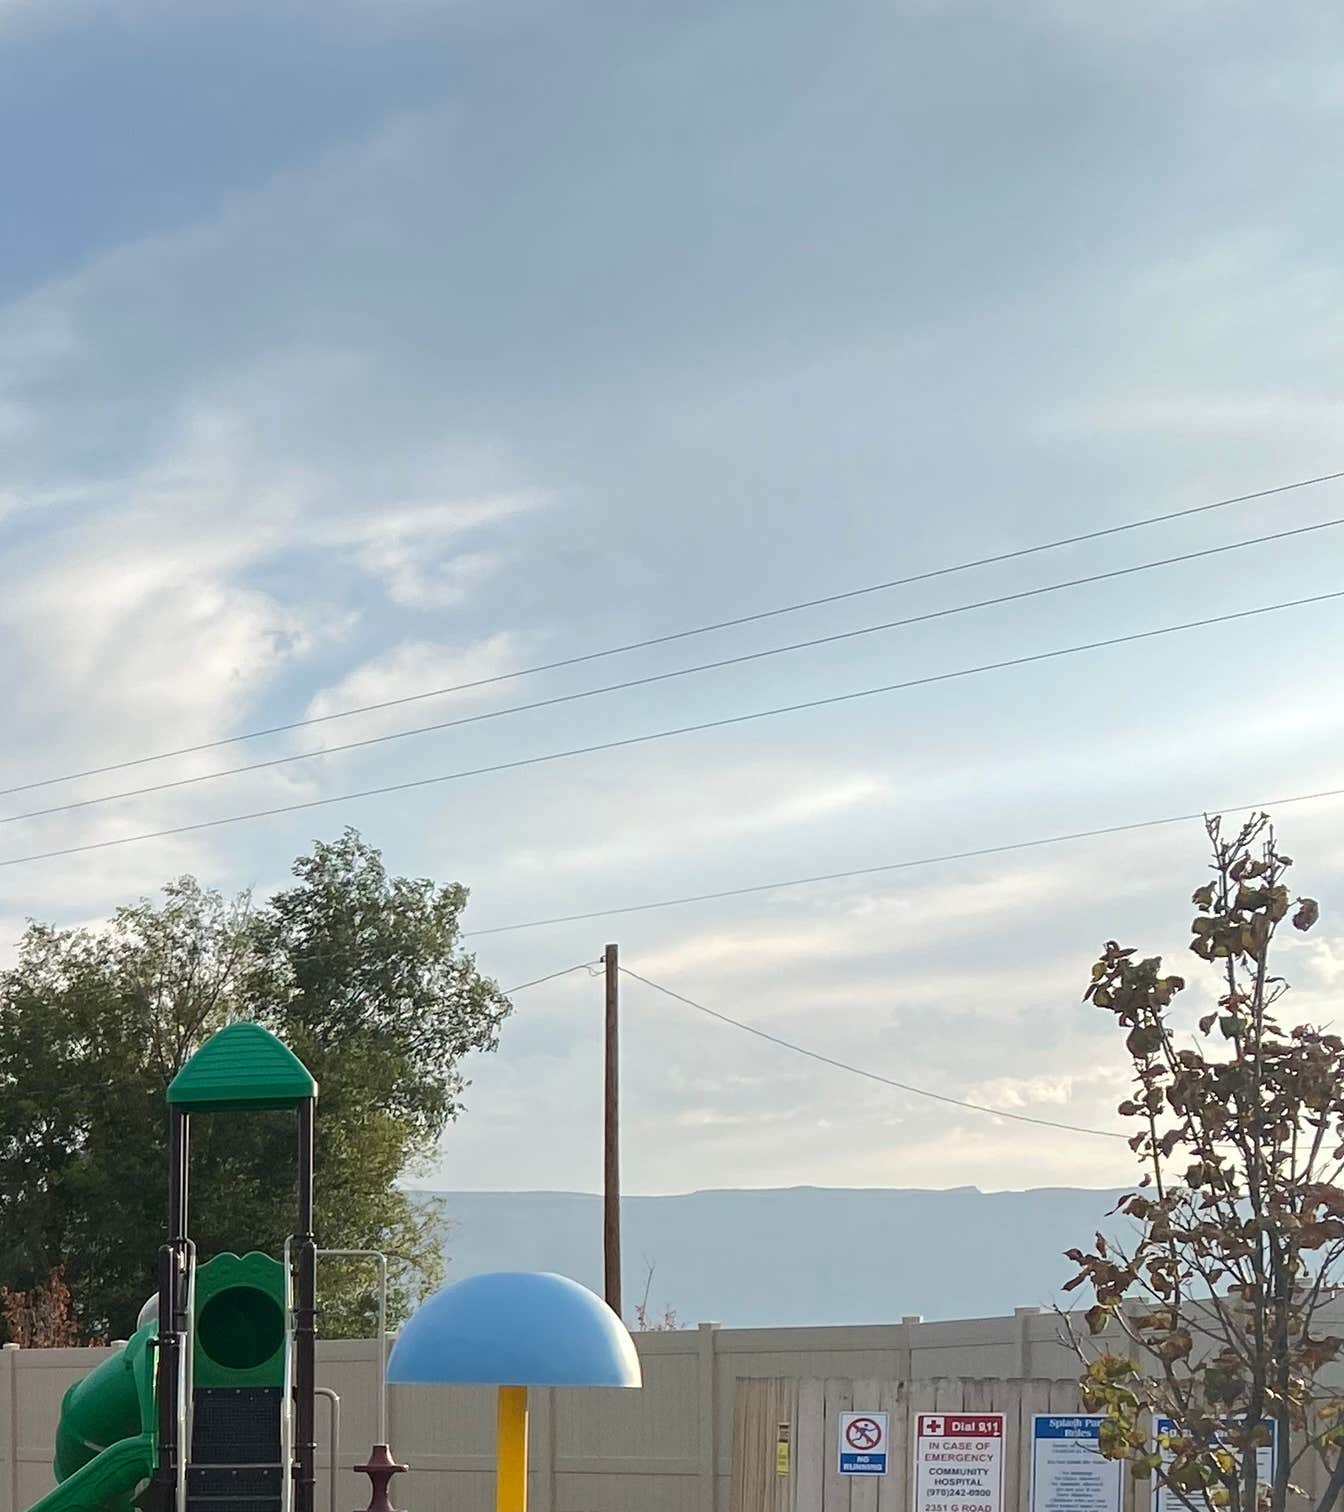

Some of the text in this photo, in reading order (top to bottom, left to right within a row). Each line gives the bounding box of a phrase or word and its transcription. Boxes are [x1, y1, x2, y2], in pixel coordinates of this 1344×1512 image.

[952, 1421, 999, 1433] Dial 911
[1048, 1419, 1082, 1429] Splash
[1064, 1429, 1092, 1437] Rules
[928, 1442, 991, 1450] IN CASE OF
[924, 1453, 994, 1462] EMERGENCY
[843, 1463, 883, 1471] RUNNING
[928, 1467, 990, 1476] COMMUNITY
[934, 1478, 983, 1487] HOSPITAL
[924, 1503, 992, 1512] 2351 G ROAD
